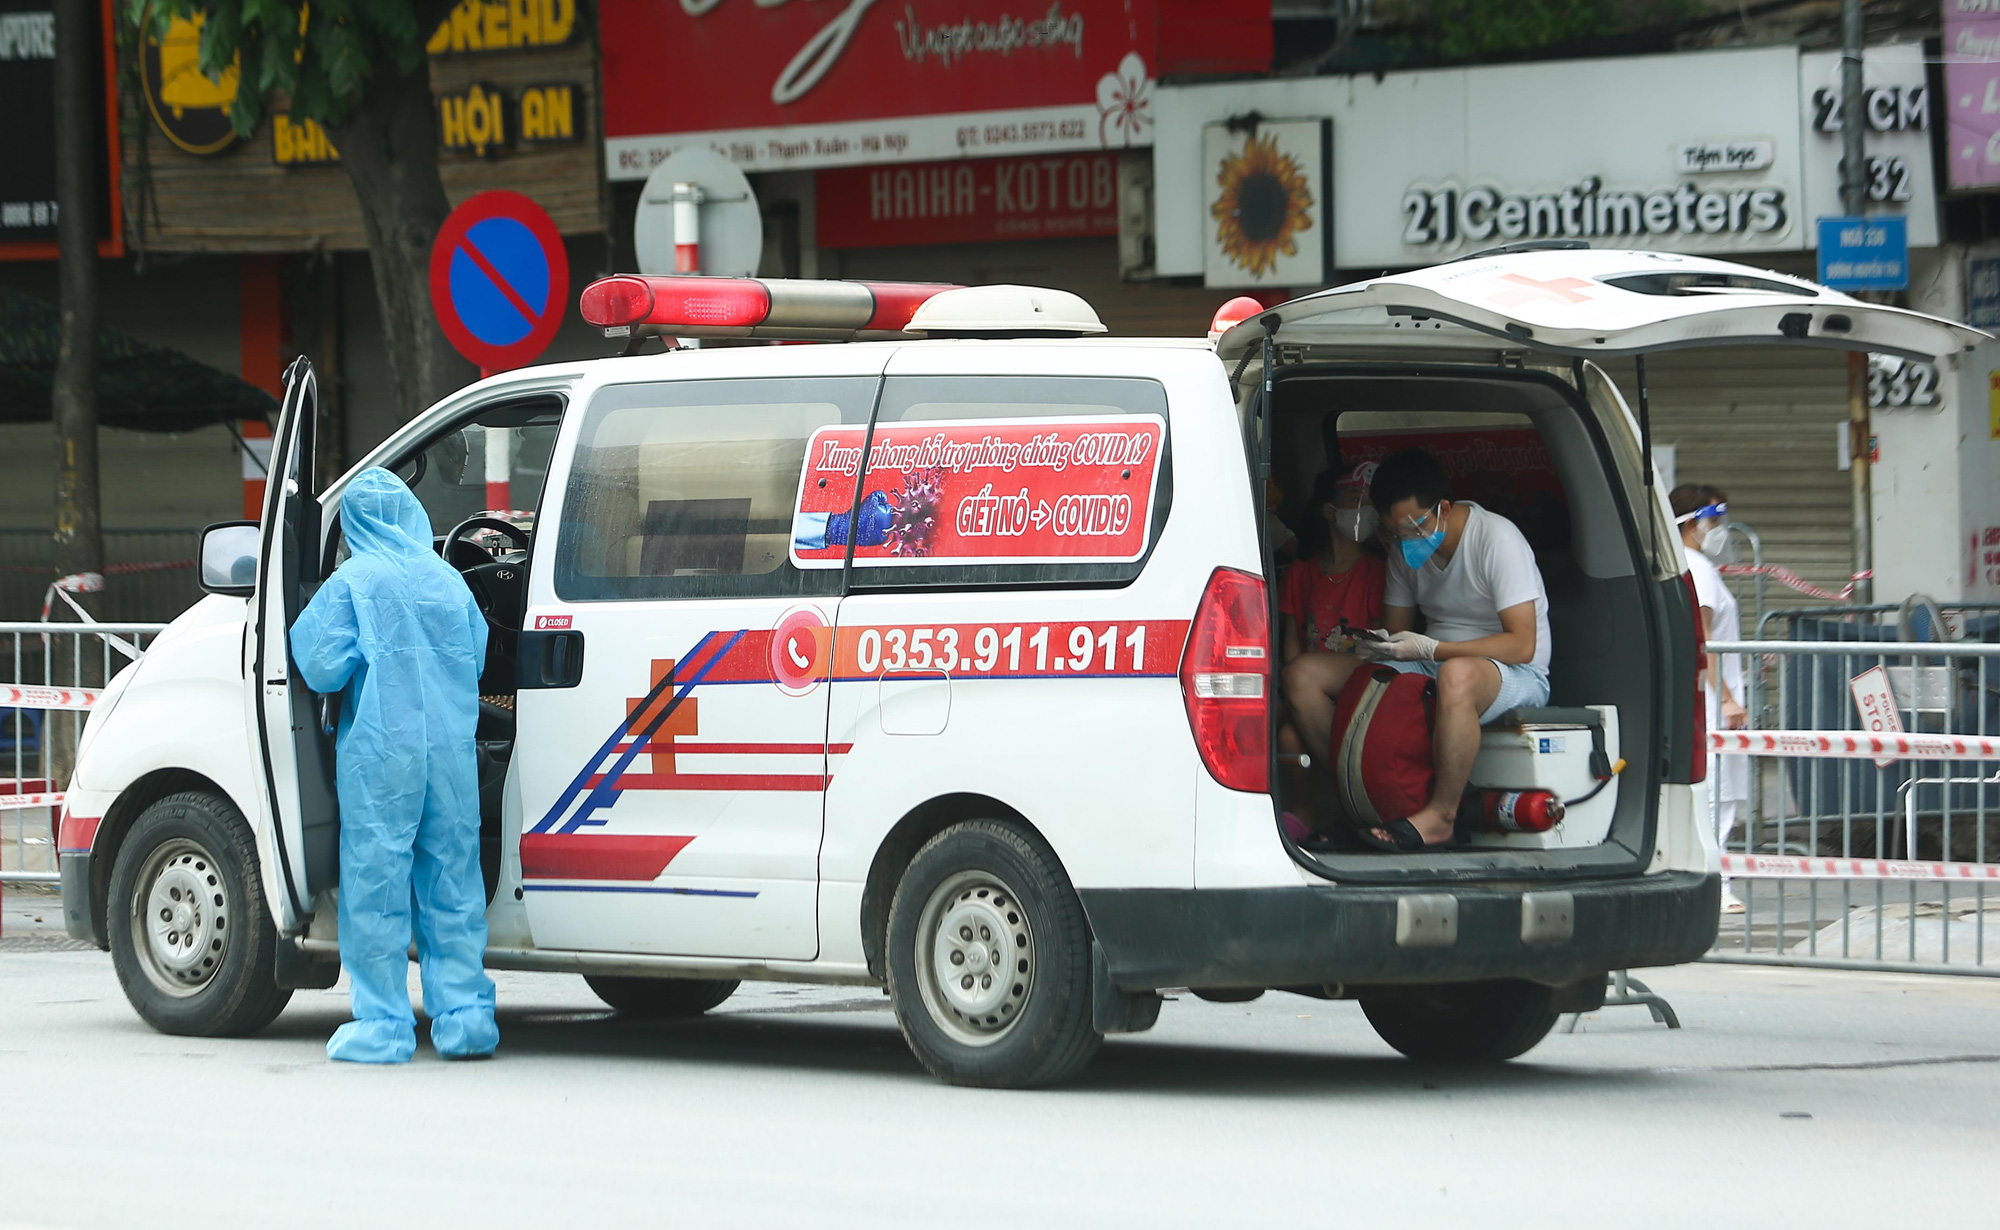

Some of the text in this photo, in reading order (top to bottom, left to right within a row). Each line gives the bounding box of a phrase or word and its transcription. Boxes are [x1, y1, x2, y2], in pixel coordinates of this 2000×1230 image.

[441, 84, 504, 157] HỘI
[522, 87, 573, 139] AN
[1814, 87, 1929, 132] 2CM
[816, 432, 1152, 477] Xung phong hỗ trợ phòng chống COVID19
[956, 483, 1132, 536] GIẾT NÓ COVID19
[547, 618, 569, 627] CLOSED
[858, 625, 1147, 673] 0353.911.911
[1880, 692, 1897, 732] POLICE
